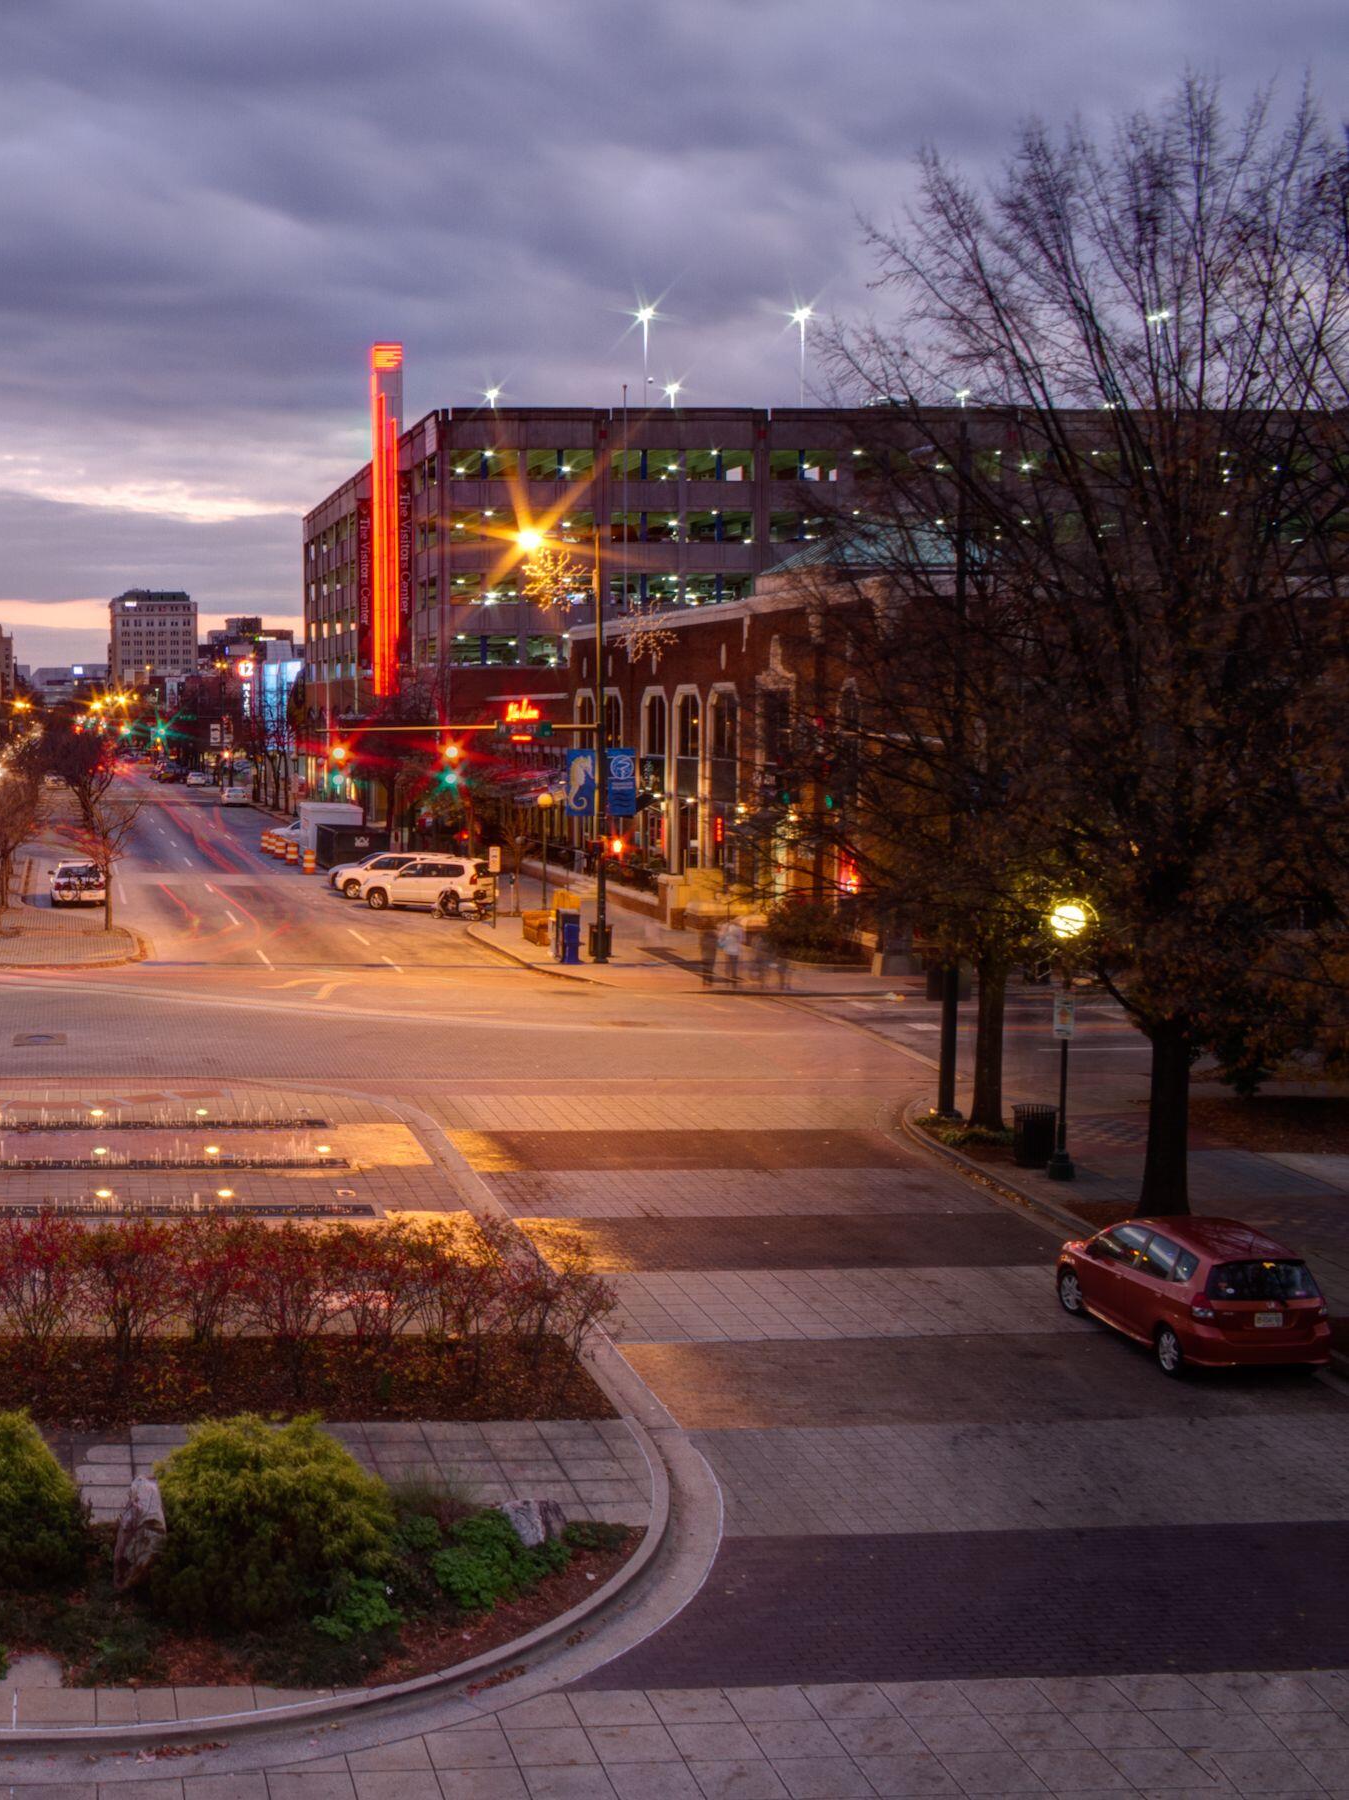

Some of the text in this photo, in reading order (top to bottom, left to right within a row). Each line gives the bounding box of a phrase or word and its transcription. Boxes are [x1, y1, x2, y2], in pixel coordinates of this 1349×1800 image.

[360, 517, 371, 626] The Visitors Center
[399, 492, 411, 615] The Visitors Center
[238, 661, 254, 677] 12
[526, 723, 538, 734] ST
